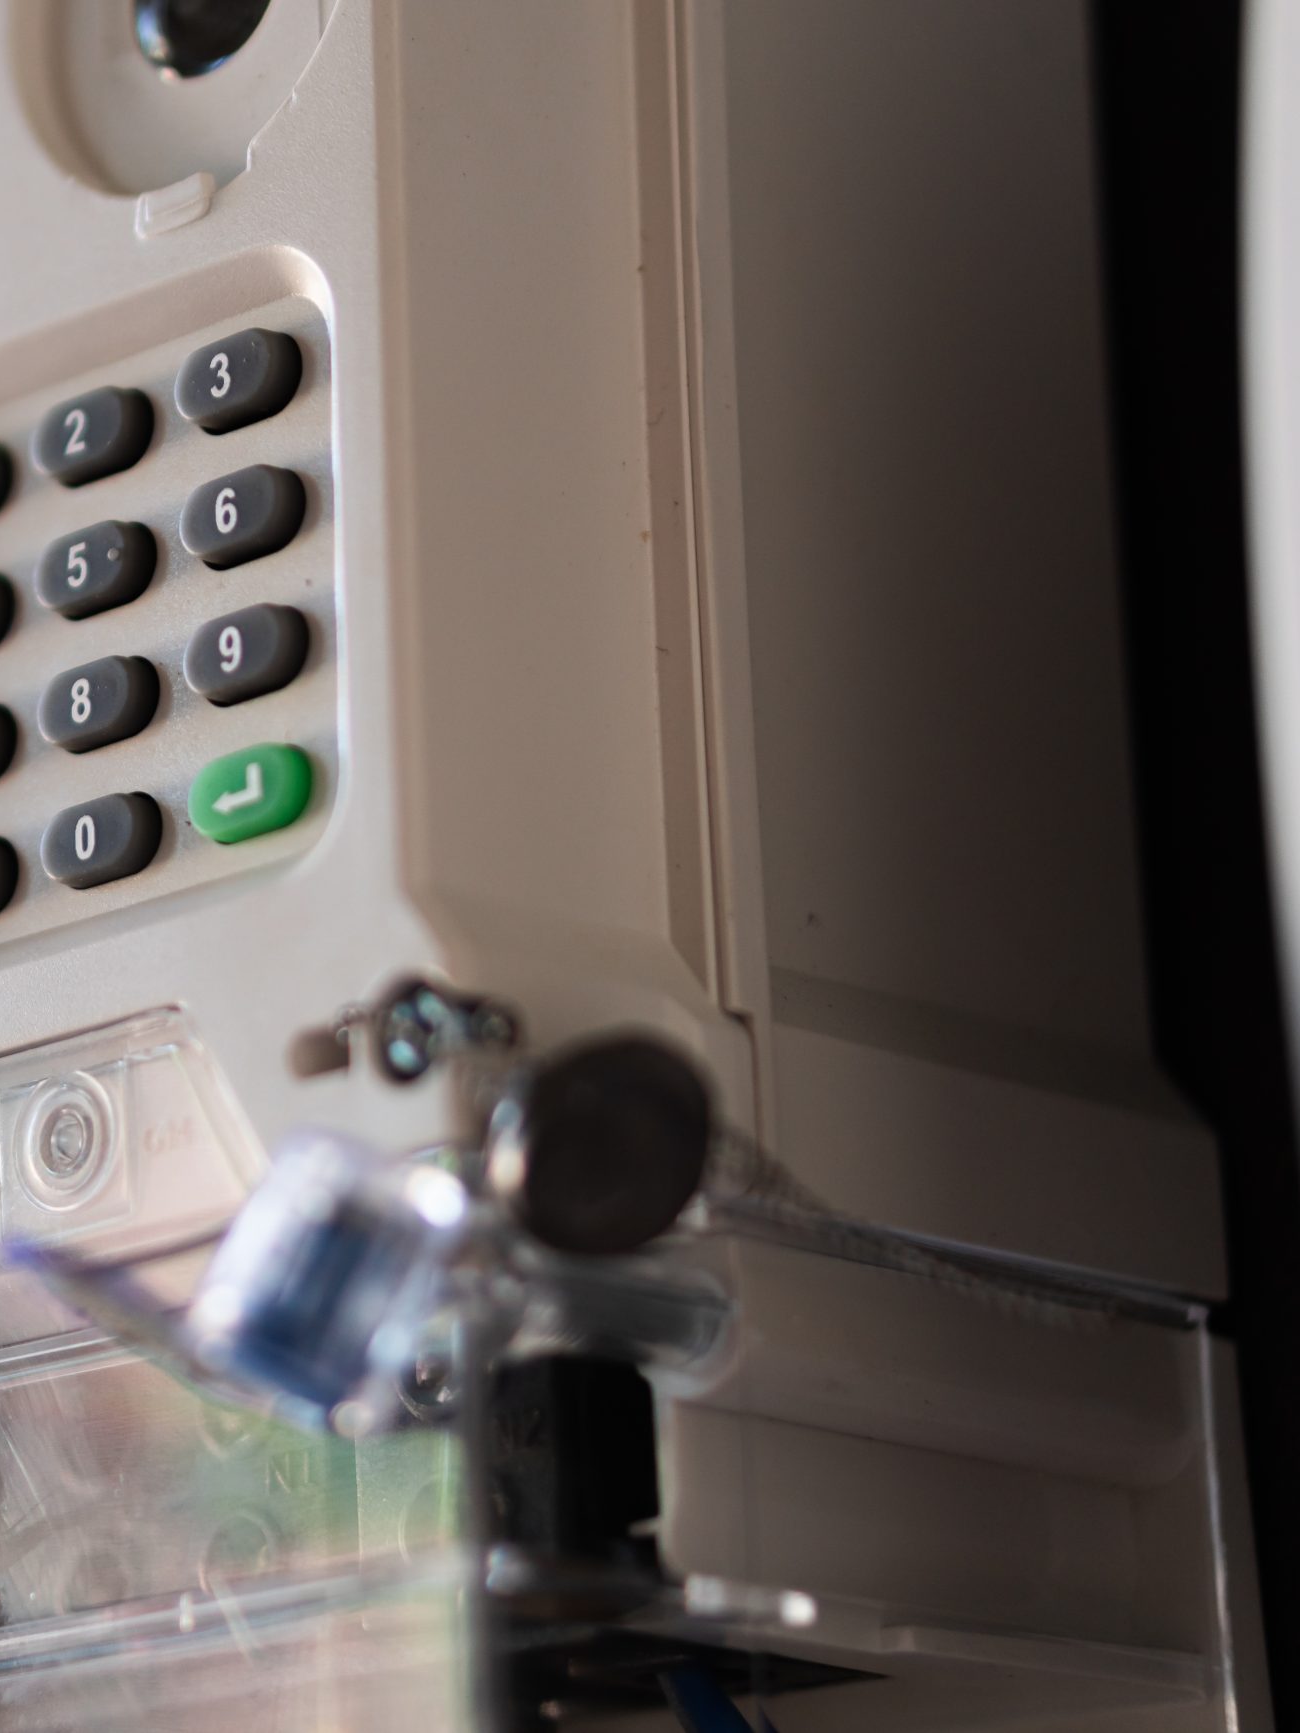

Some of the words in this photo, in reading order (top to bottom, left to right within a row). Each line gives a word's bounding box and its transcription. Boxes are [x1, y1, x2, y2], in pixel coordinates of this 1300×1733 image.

[209, 352, 231, 398] 3
[64, 409, 86, 456] 2
[214, 487, 238, 534] 6
[67, 541, 88, 588] 5
[218, 625, 242, 673] 9
[70, 677, 92, 724] 8
[74, 814, 96, 861] 0
